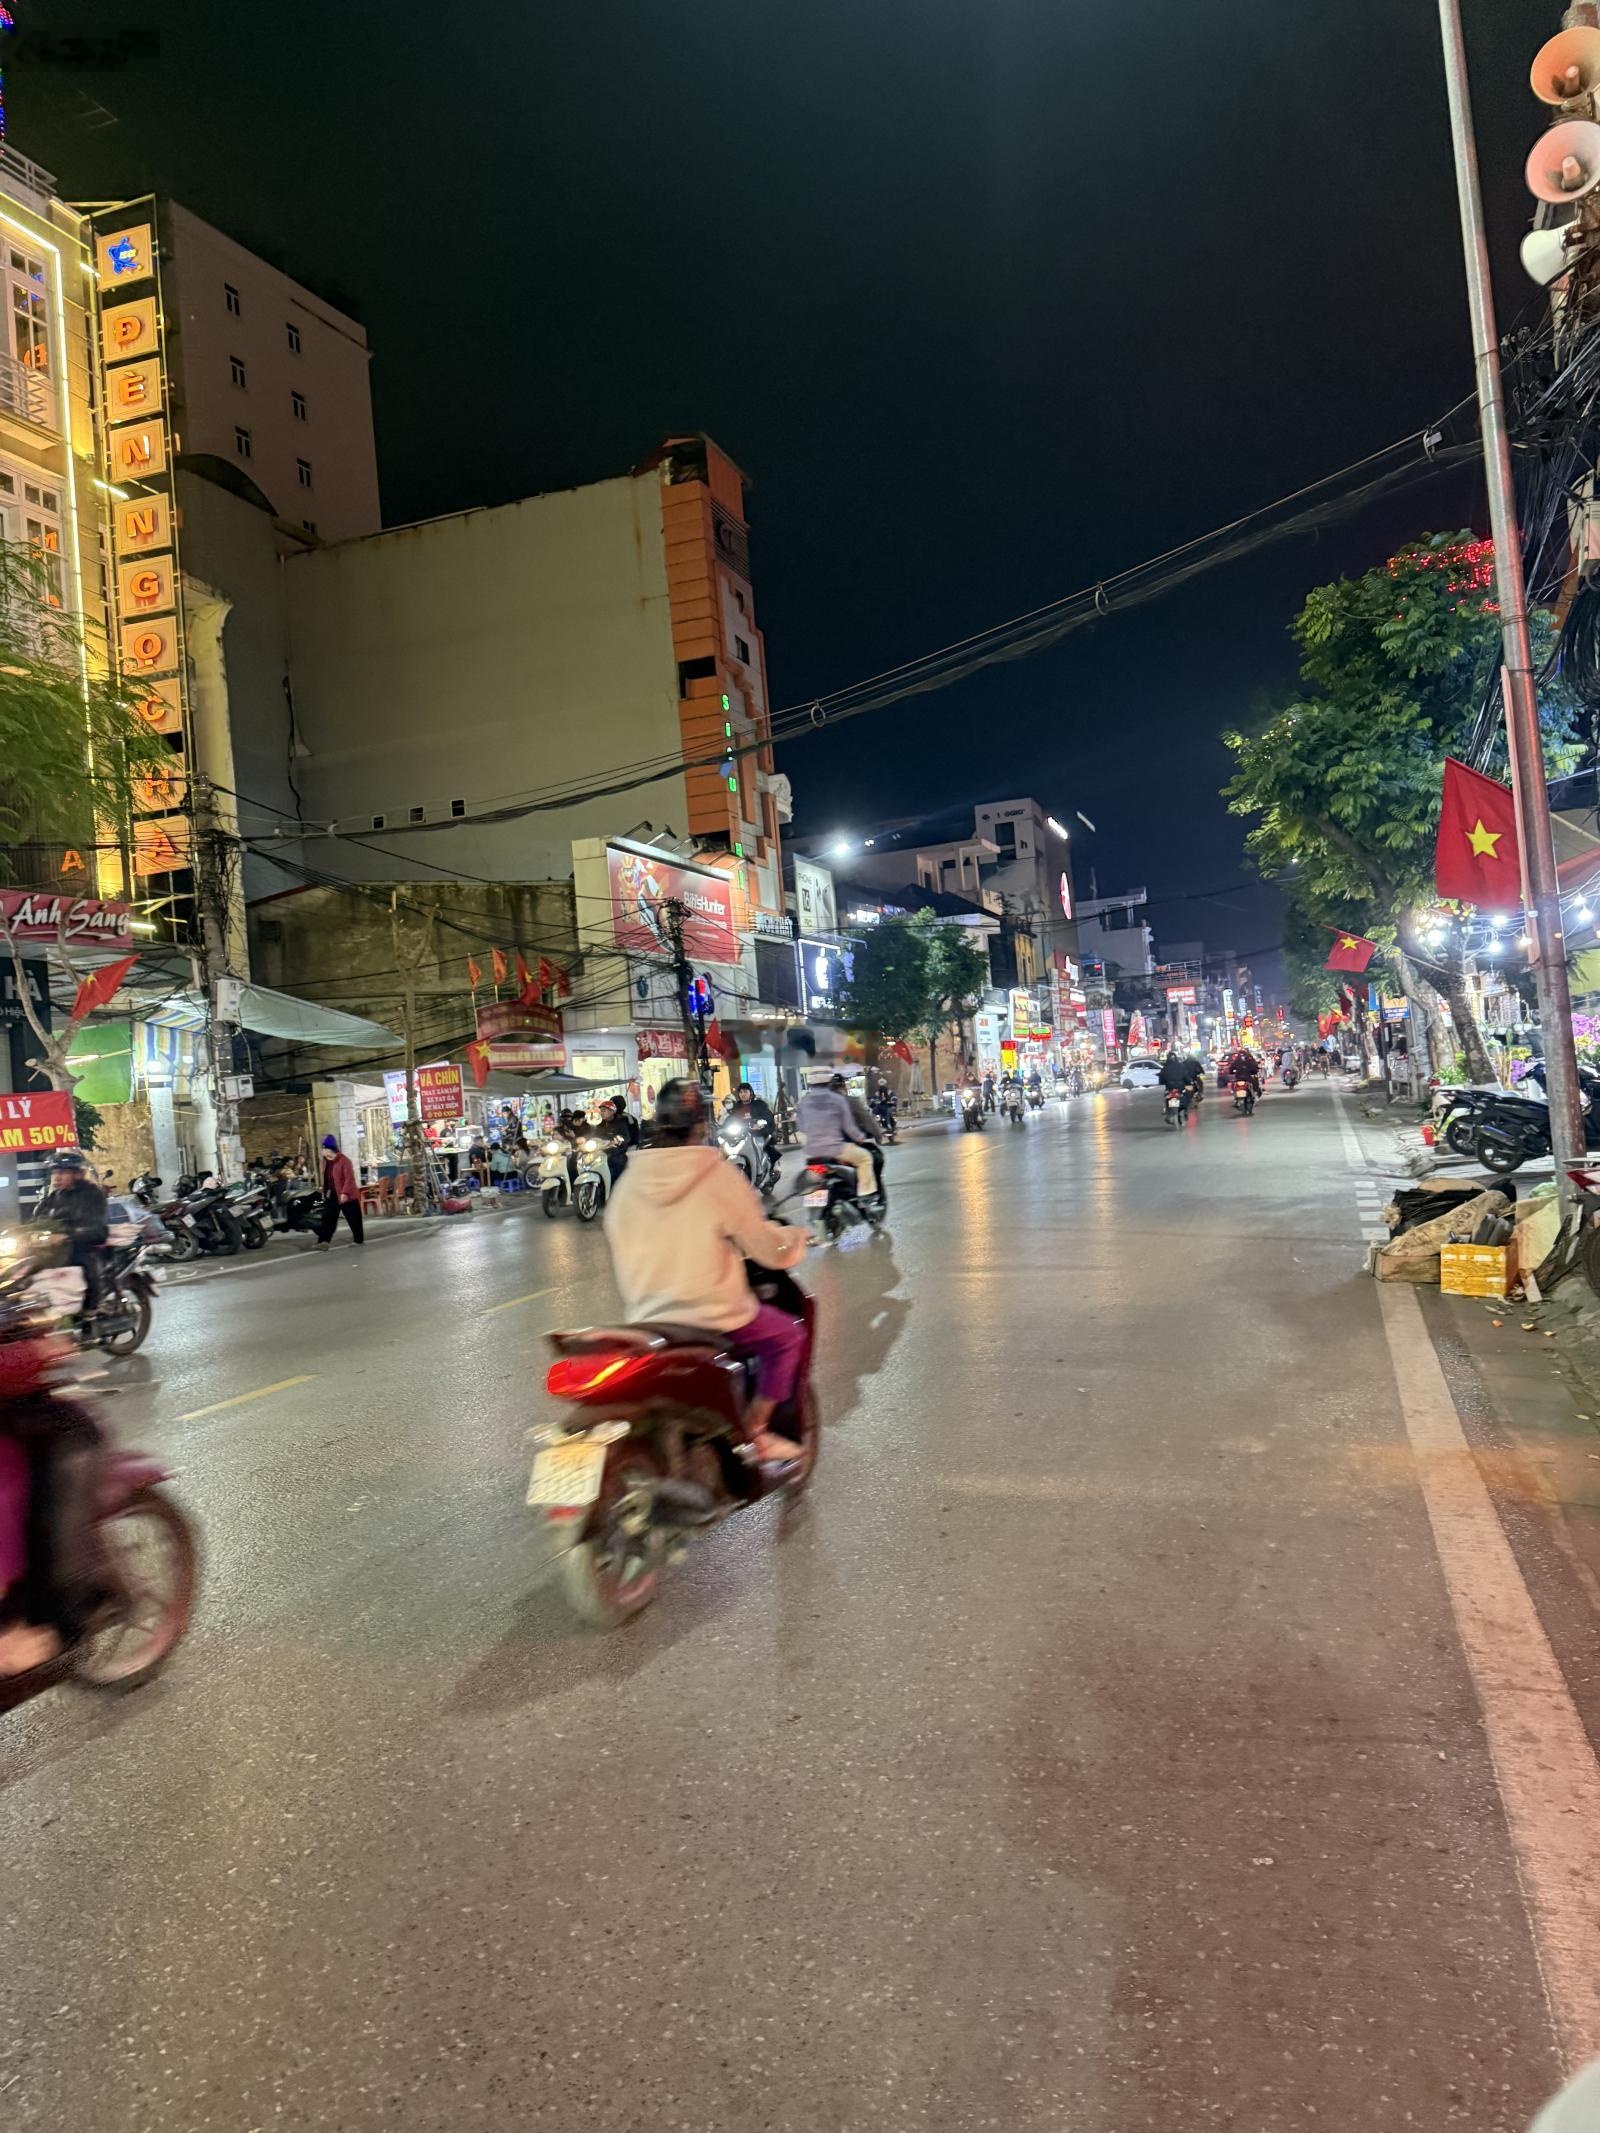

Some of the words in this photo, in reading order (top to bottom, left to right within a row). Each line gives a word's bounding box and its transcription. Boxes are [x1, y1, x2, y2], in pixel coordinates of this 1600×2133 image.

[11, 895, 61, 933] Ánh
[65, 900, 130, 937] Sáng
[6, 1096, 32, 1118] LÝ
[29, 1124, 76, 1145] 50%
